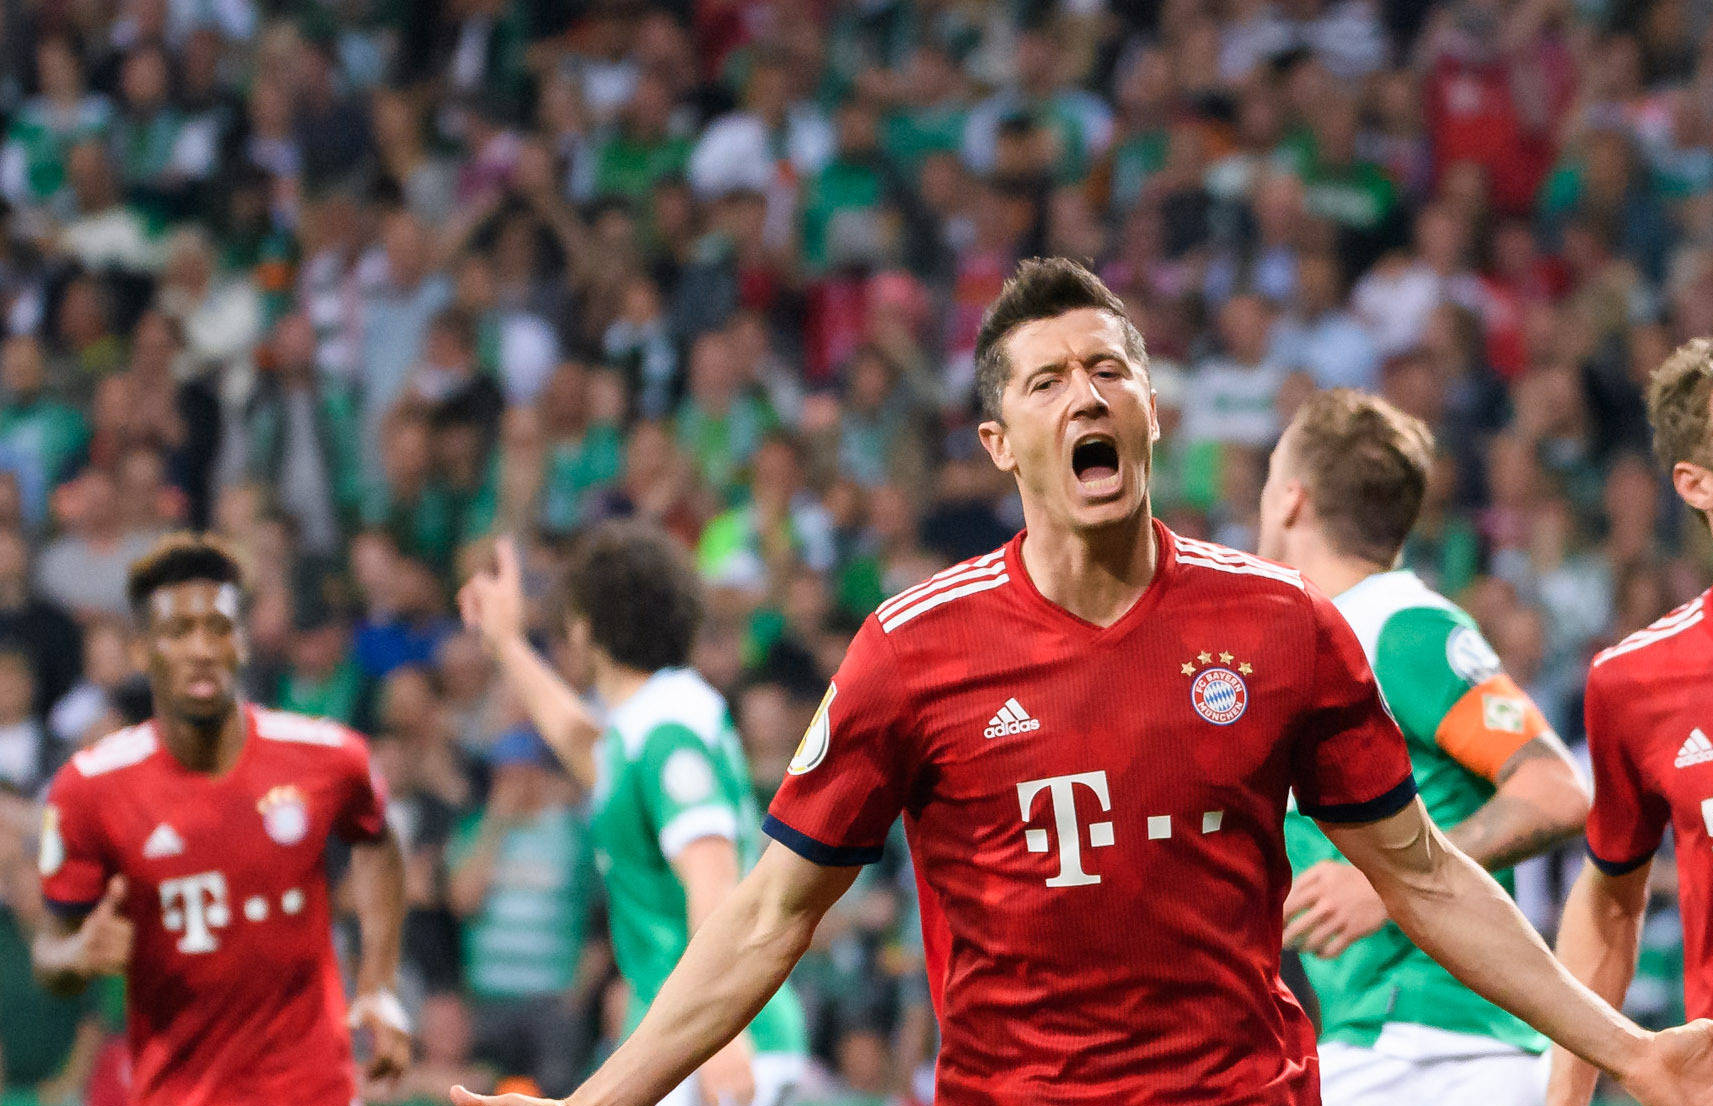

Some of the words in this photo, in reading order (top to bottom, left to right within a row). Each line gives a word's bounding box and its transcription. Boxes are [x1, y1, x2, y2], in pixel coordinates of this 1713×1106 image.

[1195, 680, 1206, 693] FC
[1205, 672, 1242, 692] BAYERN
[983, 718, 1040, 739] adidas
[1016, 770, 1114, 887] T
[160, 872, 229, 953] T
